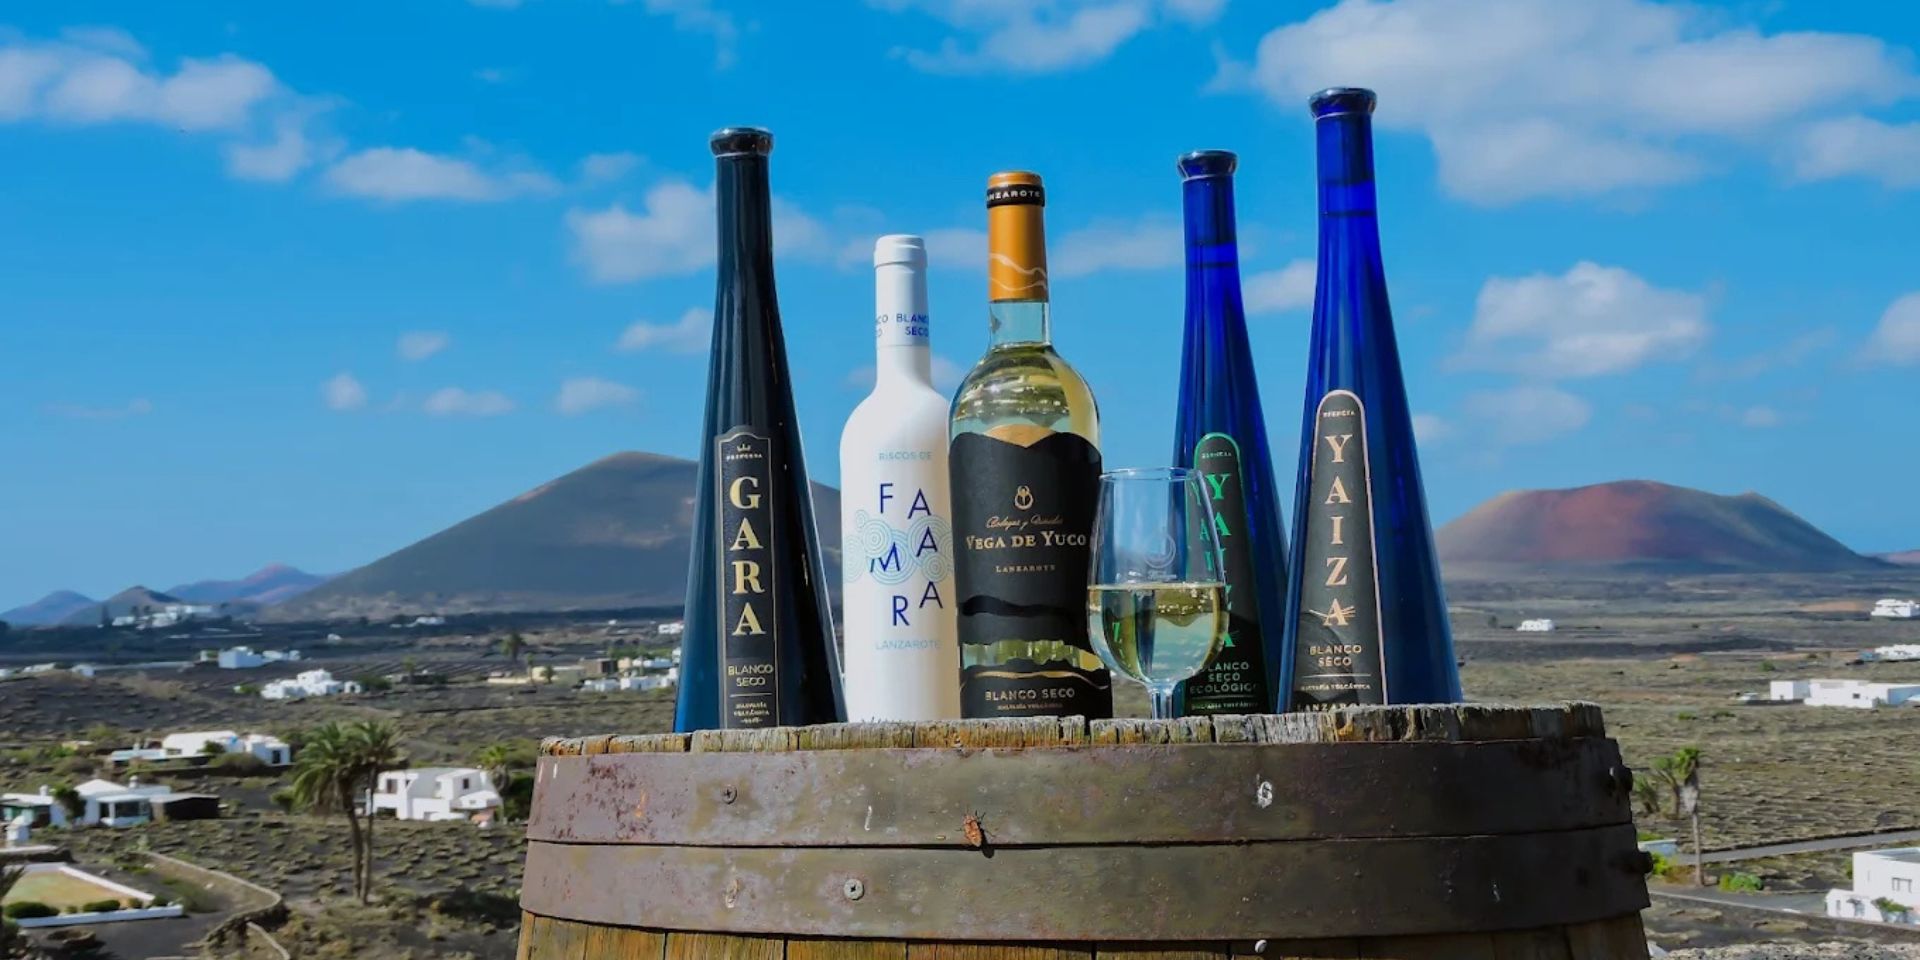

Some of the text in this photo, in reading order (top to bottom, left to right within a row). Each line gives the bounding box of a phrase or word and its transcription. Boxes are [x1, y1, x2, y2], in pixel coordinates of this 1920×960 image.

[1323, 434, 1352, 627] YAIZA
[966, 531, 1087, 550] VEGA DE YUCO
[729, 476, 767, 636] GARA
[1309, 644, 1362, 656] BLANCO
[1201, 661, 1249, 673] LANCO
[1318, 656, 1352, 667] SECO
[728, 664, 774, 676] BLANCO
[735, 677, 766, 687] SECO
[1207, 672, 1241, 682] SECO
[984, 688, 1075, 701] BLANCO SECO
